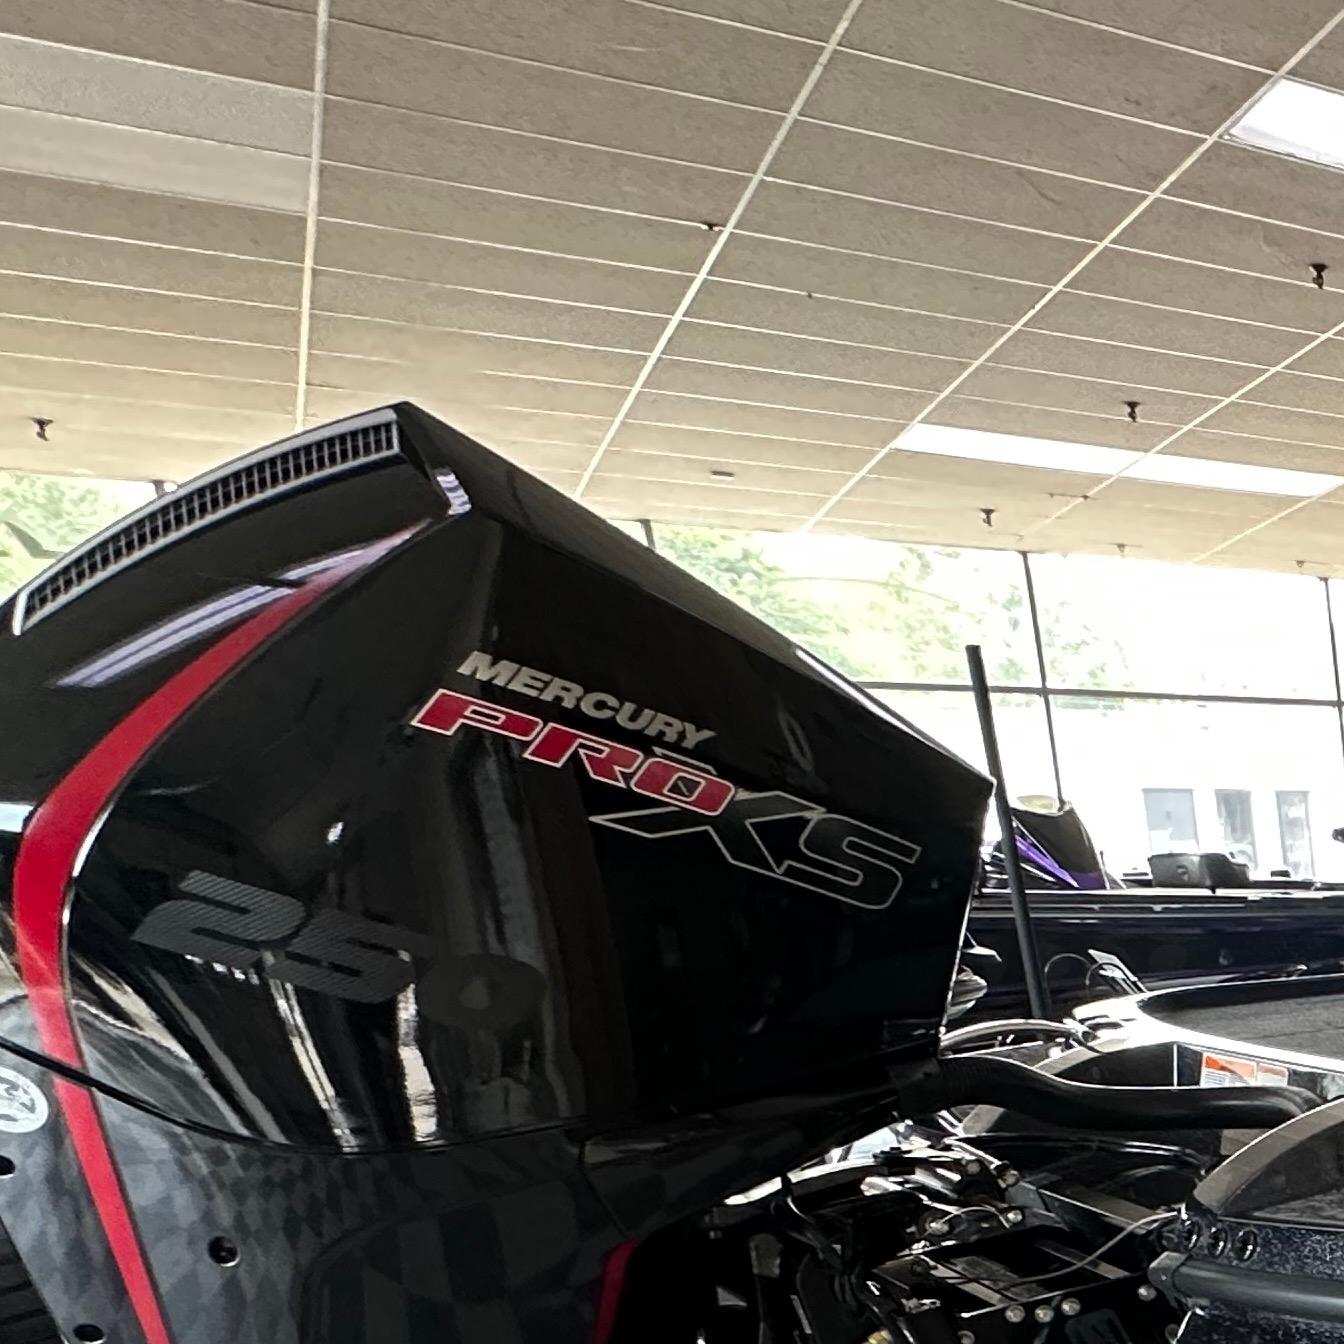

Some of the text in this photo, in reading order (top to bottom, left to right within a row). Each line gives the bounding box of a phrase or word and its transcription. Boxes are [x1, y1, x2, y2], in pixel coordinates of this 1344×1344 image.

[409, 687, 735, 818] PRO
[456, 650, 719, 752] MERCURY
[589, 749, 923, 910] XS
[130, 869, 546, 1028] 250
